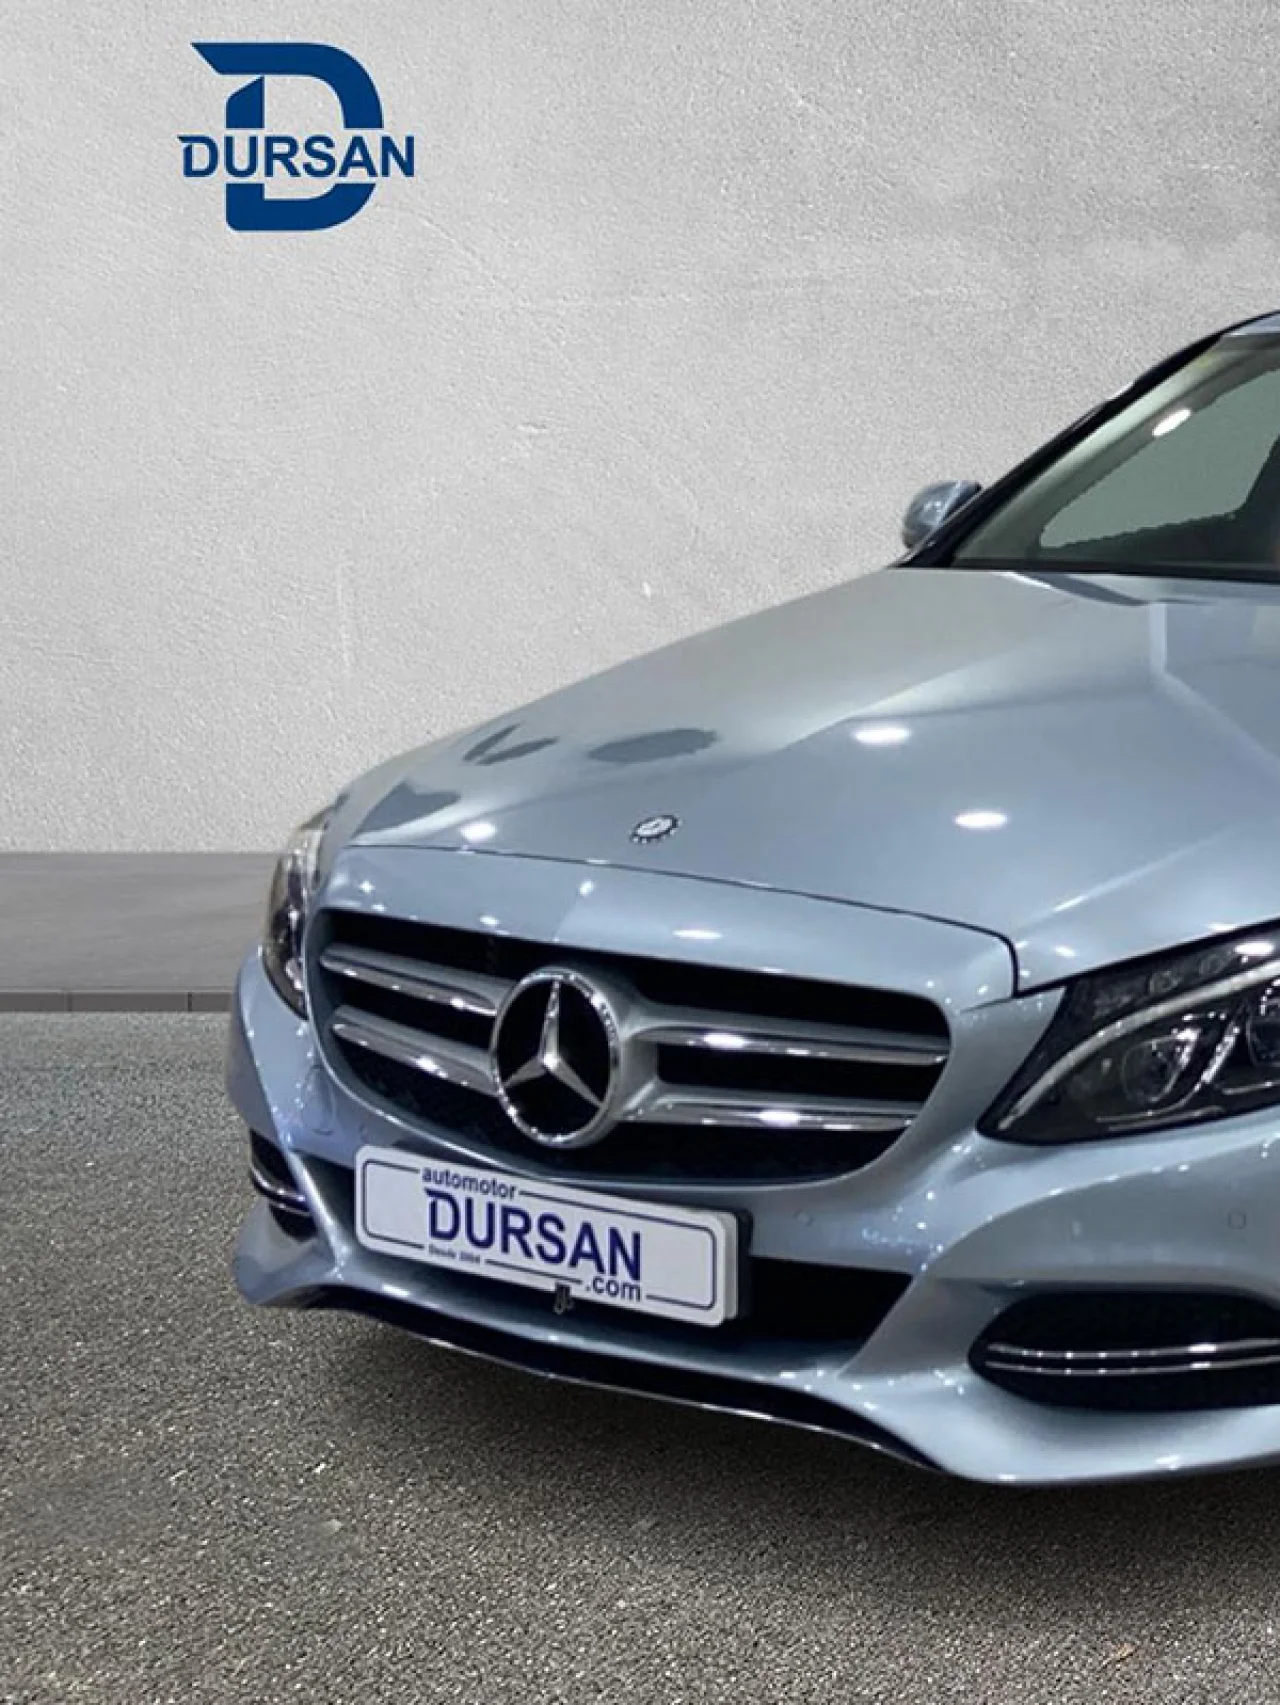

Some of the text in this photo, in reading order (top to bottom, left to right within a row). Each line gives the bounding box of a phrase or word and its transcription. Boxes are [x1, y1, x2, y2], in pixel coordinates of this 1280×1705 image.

[422, 1166, 517, 1200] automotor
[425, 1188, 641, 1280] DURSAN
[586, 1274, 642, 1302] .com
